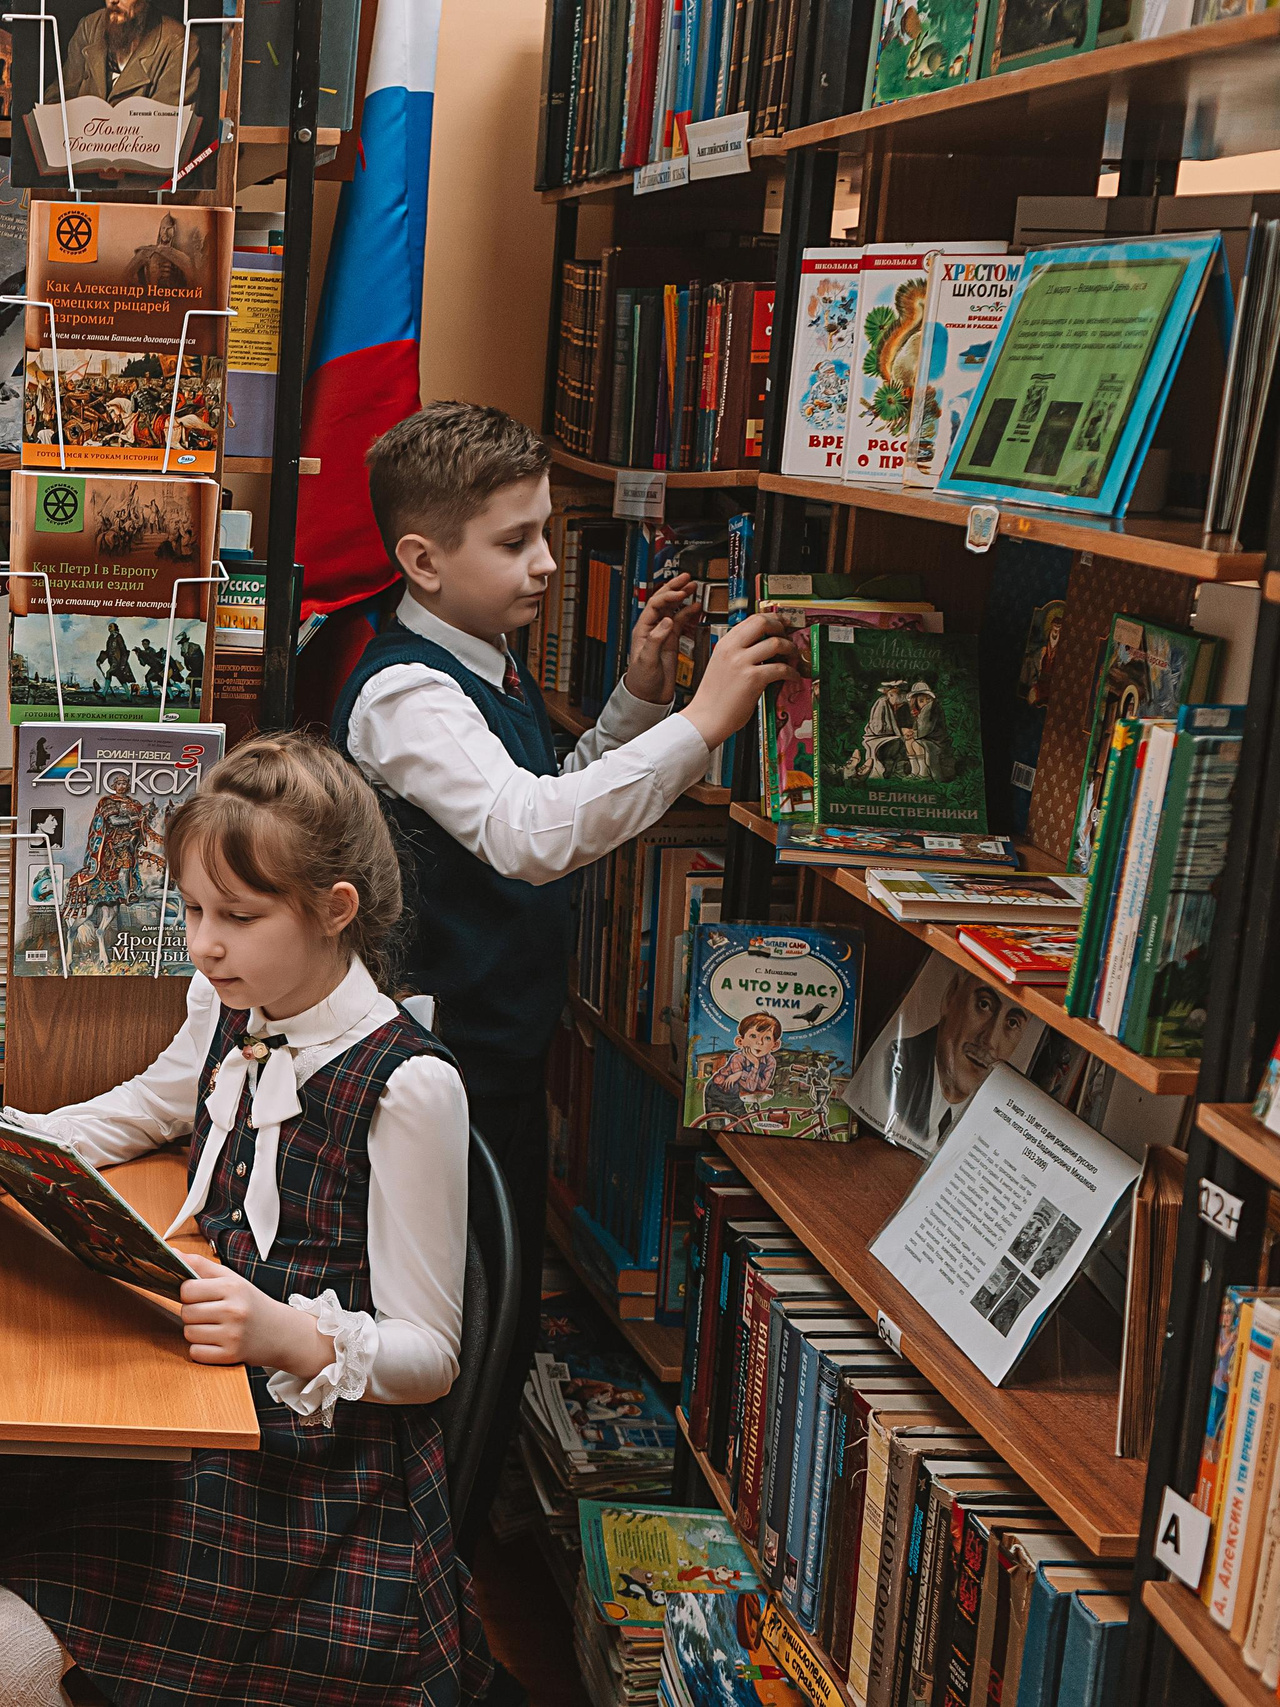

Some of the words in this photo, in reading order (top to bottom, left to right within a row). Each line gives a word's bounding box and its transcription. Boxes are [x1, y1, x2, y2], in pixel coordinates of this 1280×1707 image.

[573, 6, 581, 37] High
[570, 42, 578, 79] School
[564, 84, 575, 149] Dictionary
[83, 117, 140, 138] Помни
[63, 134, 160, 154] Достоевского
[697, 140, 728, 158] Английский
[730, 140, 742, 152] язык
[192, 147, 212, 166] УЧИТЕЛЯ
[57, 210, 92, 223] ОТКРЫВАЕМ
[58, 247, 88, 256] ИСТОРИЮ
[874, 258, 917, 266] ШКОЛЬНАЯ
[942, 263, 1020, 281] ХРЕСТОМ
[46, 280, 70, 293] Как
[74, 280, 144, 298] Александр
[147, 285, 203, 300] Невский
[1078, 283, 1110, 296] Всемирный
[46, 296, 110, 312] немецких
[114, 300, 170, 316] рыцарей
[44, 311, 114, 328] разгромил
[86, 334, 110, 344] ханом
[111, 334, 142, 344] Батыем
[858, 454, 870, 467] О
[44, 484, 78, 494] ОТКРЫВАЕМ
[46, 518, 74, 526] ИСТОРИЮ
[32, 562, 56, 574] Как
[59, 563, 90, 576] Петр
[102, 567, 108, 575] в
[112, 564, 158, 580] Европу
[32, 580, 44, 588] за
[50, 580, 104, 594] науками
[107, 581, 144, 591] ездил
[64, 599, 102, 608] столицу
[114, 599, 136, 608] Неве
[860, 658, 931, 675] Зощенко
[24, 711, 69, 720] ГОТОВИМЯ
[96, 750, 171, 760] РОМАН-ГАЗЕТА
[175, 745, 204, 769] 3
[868, 790, 937, 805] ВЕЛИКИЕ
[829, 802, 978, 820] ПУТЕШЕСТВЕННИКИ
[764, 940, 788, 948] ЧИТАЕМ
[788, 942, 806, 950] САМИ
[764, 968, 798, 976] Михалков
[810, 950, 838, 969] БОЛЬШИЕ
[837, 968, 851, 989] БУКВЫ
[721, 978, 732, 990] А
[738, 978, 772, 993] ЧТО
[776, 981, 789, 994] У
[793, 982, 838, 998] ВАС?
[756, 996, 800, 1010] СТИХИ
[30, 1146, 90, 1180] ГУД
[1034, 1140, 1073, 1173] Владимировича
[1068, 1167, 1098, 1193] Михалкова
[1202, 1186, 1240, 1229] 12+
[878, 1318, 894, 1345] 6+
[799, 1352, 808, 1395] ДЕТЕЙ
[741, 1320, 770, 1493] ЭНЦИКЛОПЕДИЯ
[1238, 1409, 1259, 1462] ВРЕМЕНЕМ
[811, 1408, 828, 1498] ЛИТЕРАТУРА
[805, 1510, 818, 1577] РУССКАЯ
[1161, 1513, 1180, 1556] А
[1214, 1497, 1246, 1589] Алексин
[1211, 1595, 1227, 1615] А.
[926, 1589, 941, 1663] литературных
